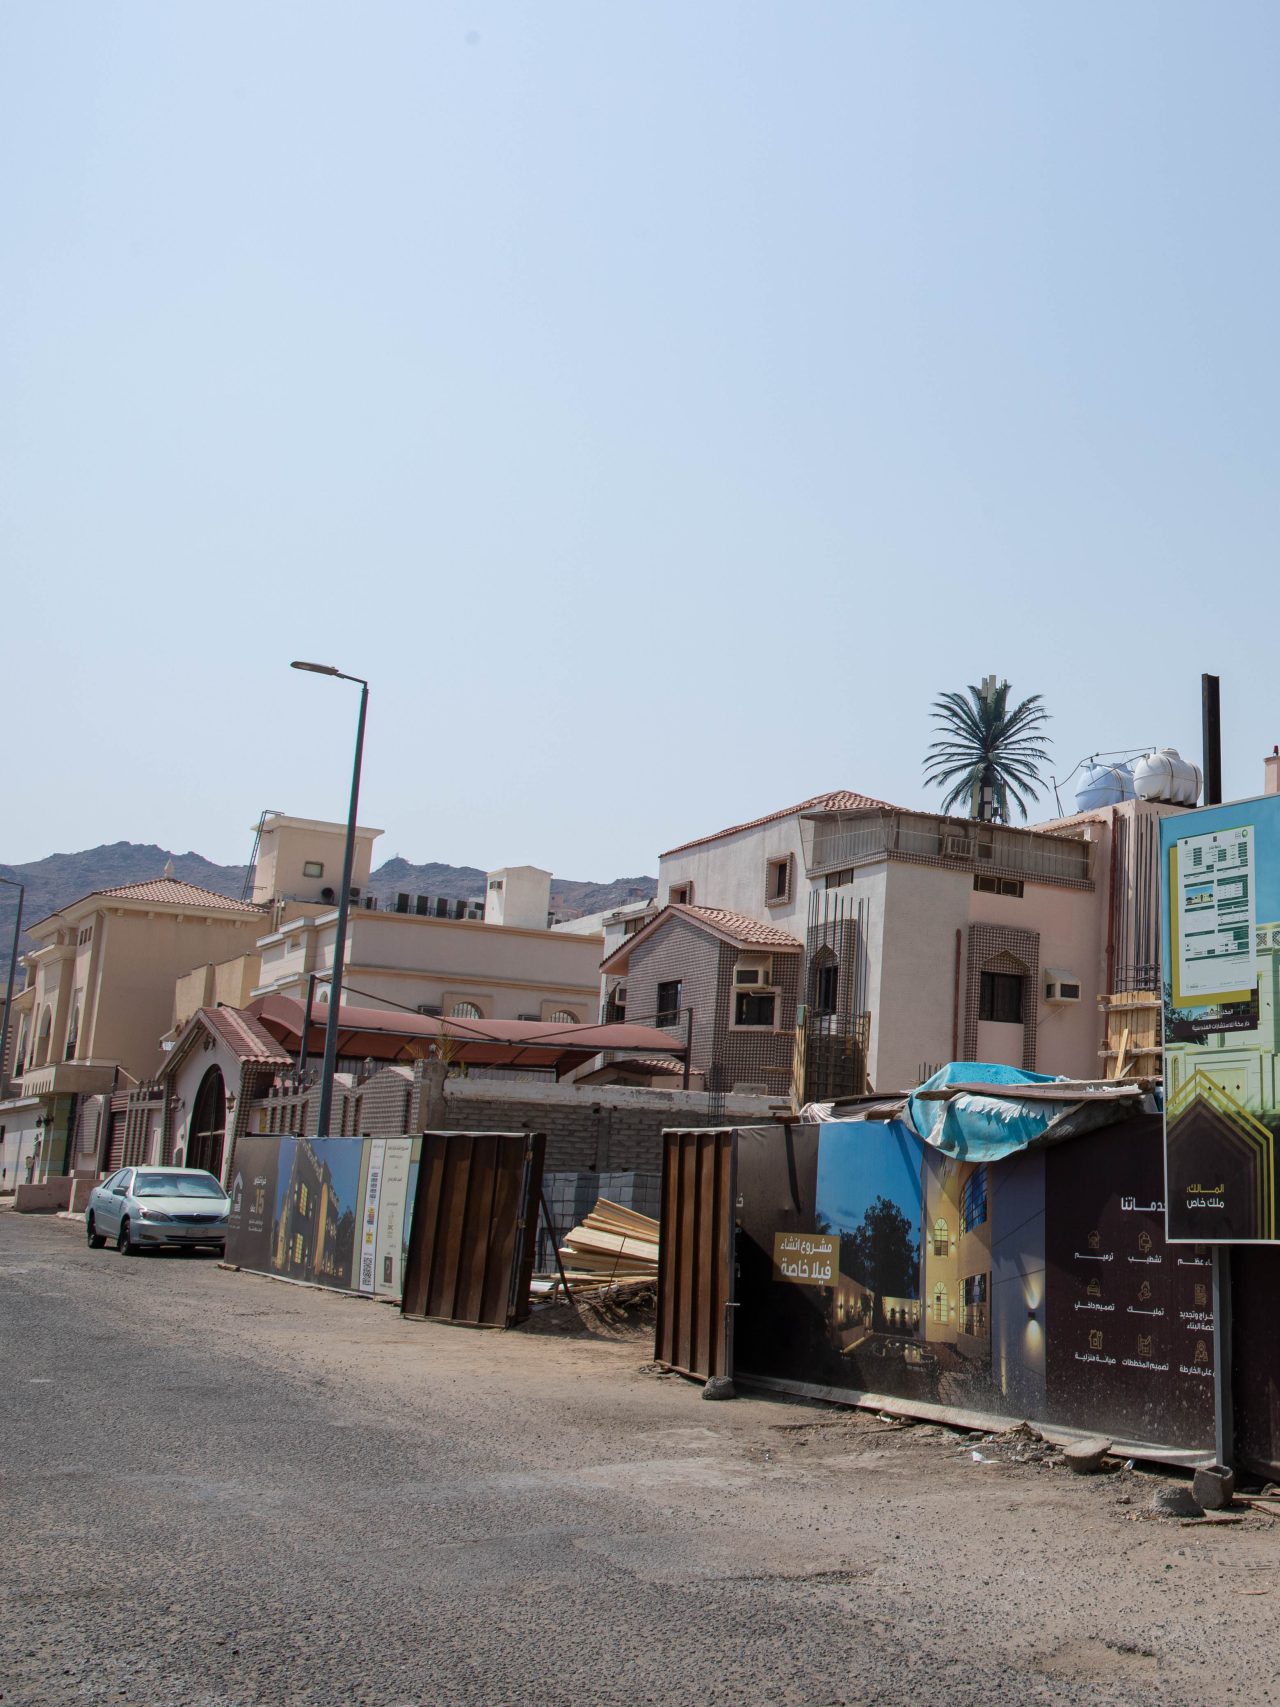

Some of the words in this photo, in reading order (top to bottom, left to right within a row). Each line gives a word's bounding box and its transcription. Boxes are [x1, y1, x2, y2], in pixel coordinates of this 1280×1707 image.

[1186, 1198, 1206, 1209] خاص
[1207, 1198, 1225, 1209] ملك
[780, 1236, 800, 1251] انشاء
[800, 1238, 833, 1255] مشروع
[1074, 1252, 1114, 1262] ترميم
[1127, 1254, 1162, 1265] تشطيب
[1177, 1257, 1204, 1267] عظم
[780, 1257, 809, 1278] خاصة
[811, 1260, 832, 1285] فيلا
[1095, 1303, 1115, 1312] تصميم
[1127, 1305, 1165, 1316] تمليك
[1186, 1322, 1201, 1332] البناء
[1096, 1353, 1117, 1365] صيانة
[1149, 1362, 1170, 1371] تصميم
[1201, 1368, 1212, 1377] على
